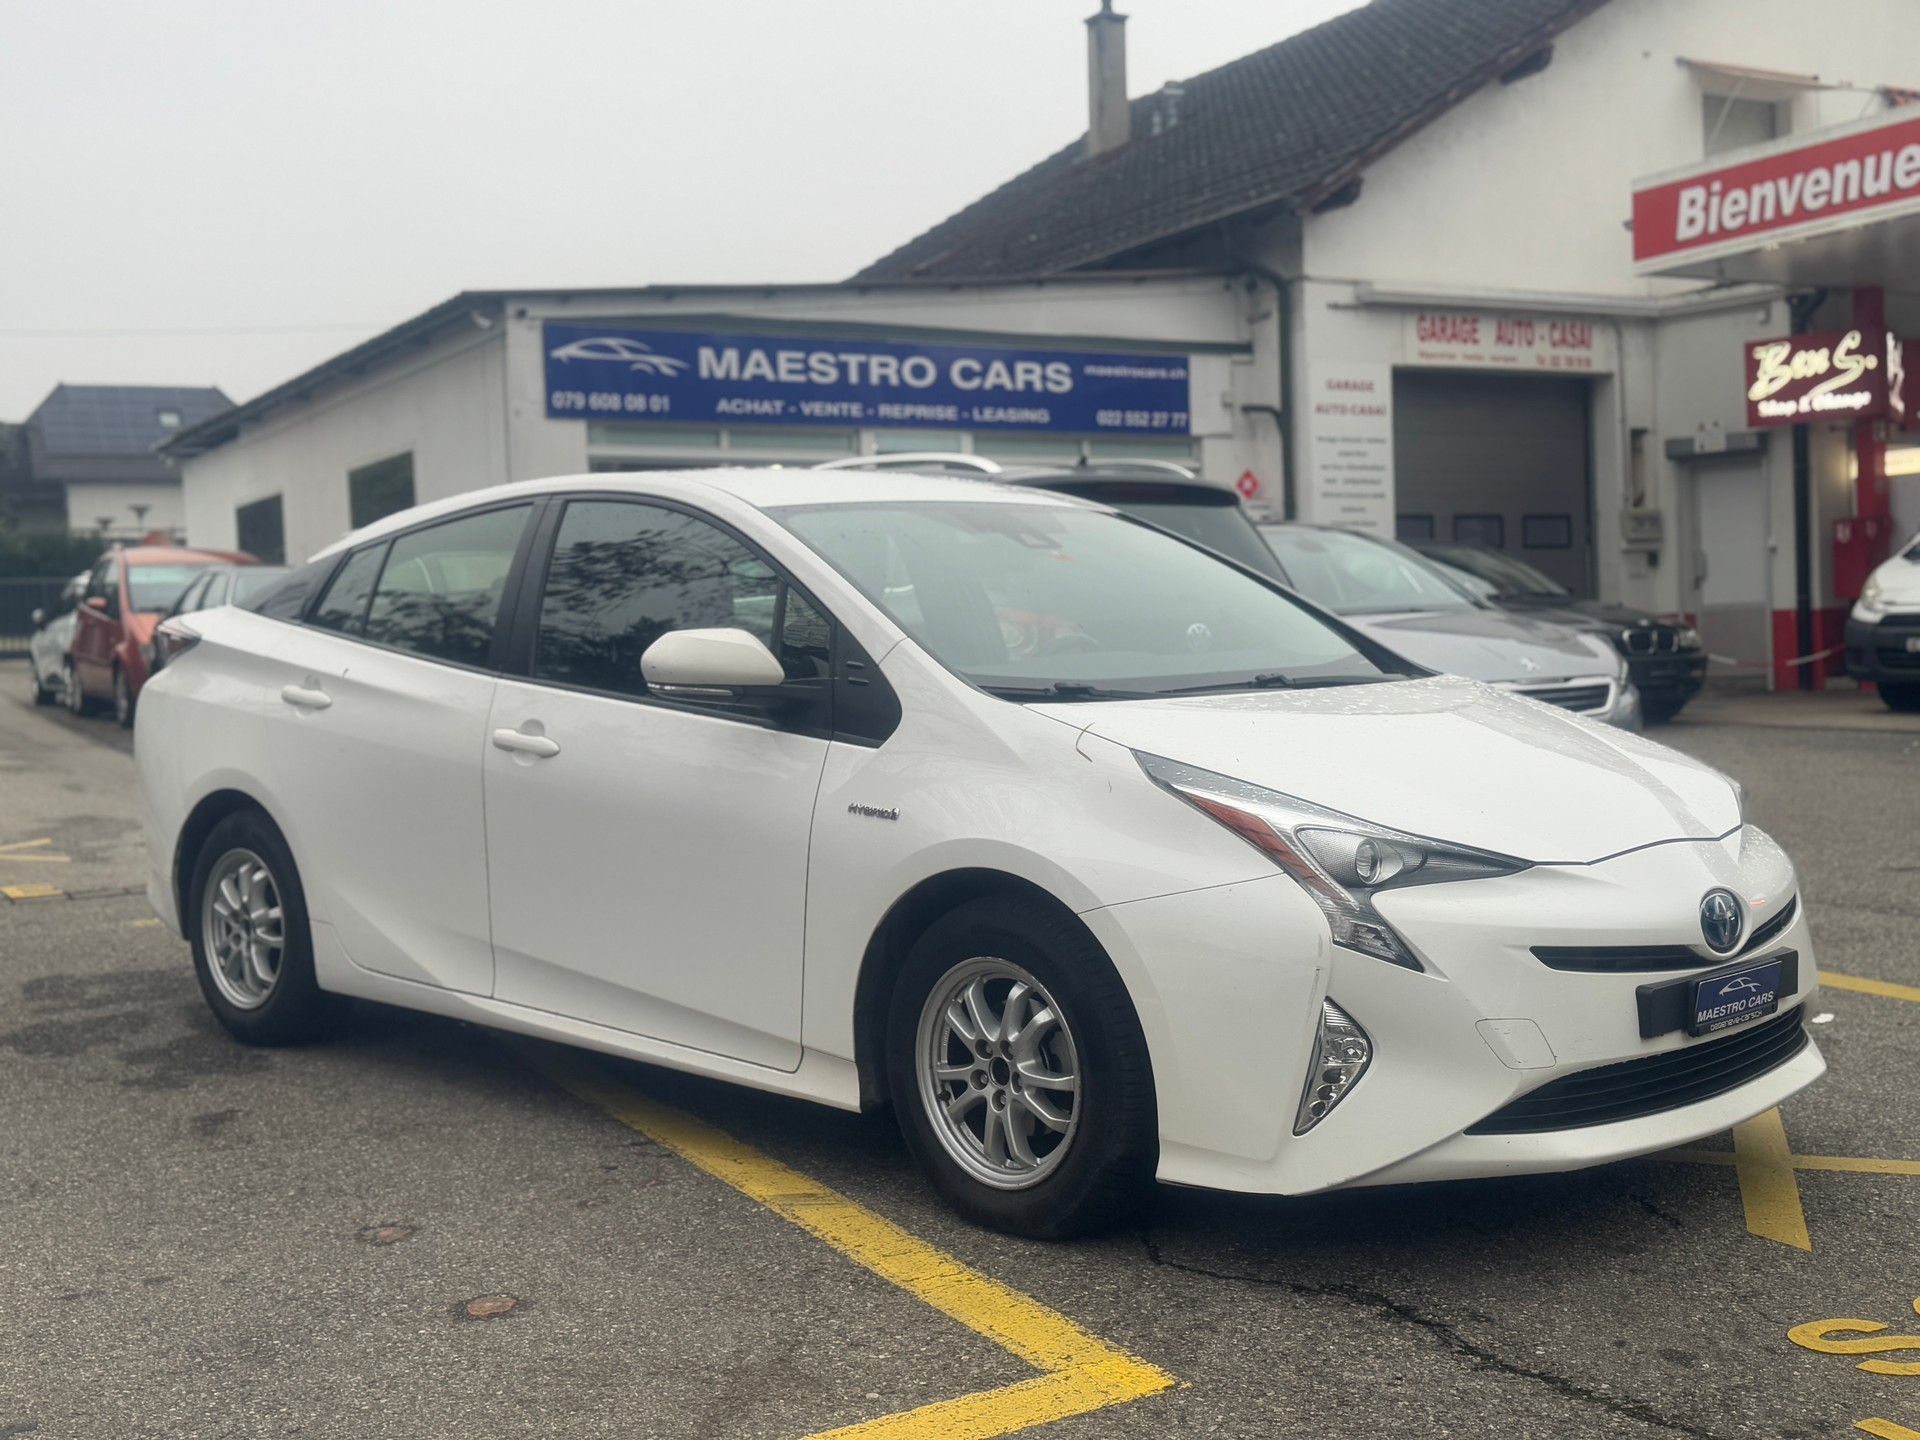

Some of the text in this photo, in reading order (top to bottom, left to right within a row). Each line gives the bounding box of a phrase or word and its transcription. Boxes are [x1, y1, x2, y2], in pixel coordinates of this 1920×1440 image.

[1675, 144, 1920, 243] Bienvenue
[1416, 314, 1480, 345] GARAGE
[1494, 319, 1536, 348] AUTO
[698, 346, 1074, 394] MAESTRO CARS
[715, 397, 785, 415] ACHAT
[799, 400, 864, 419] VENTE
[878, 403, 959, 421] REPRISE
[972, 406, 1051, 424] LEASING
[1697, 990, 1775, 1023] MAESTRO CARS
